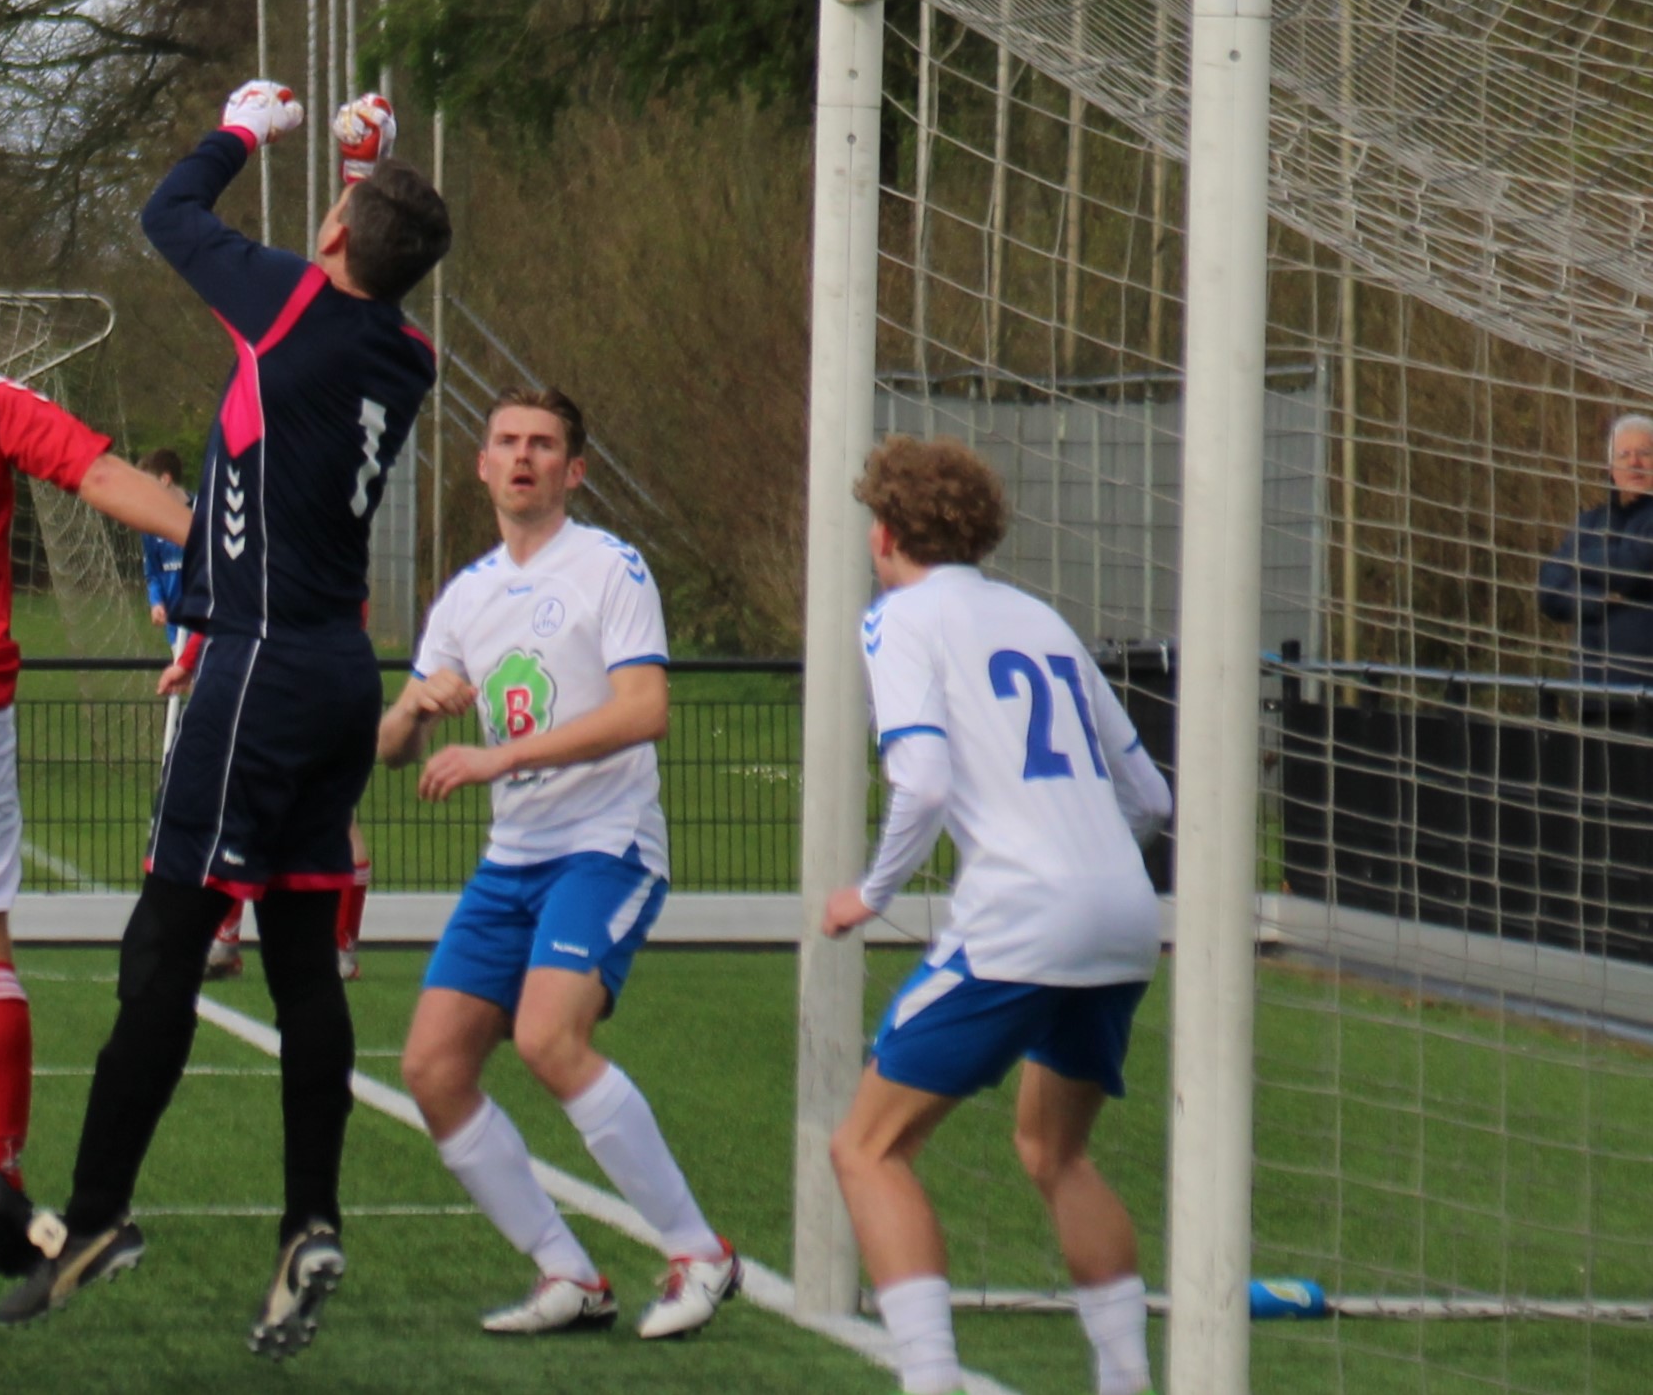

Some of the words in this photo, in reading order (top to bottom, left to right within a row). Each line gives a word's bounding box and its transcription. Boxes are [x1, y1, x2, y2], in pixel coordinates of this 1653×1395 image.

[350, 397, 386, 518] 1
[506, 688, 536, 738] B
[988, 649, 1110, 781] 21
